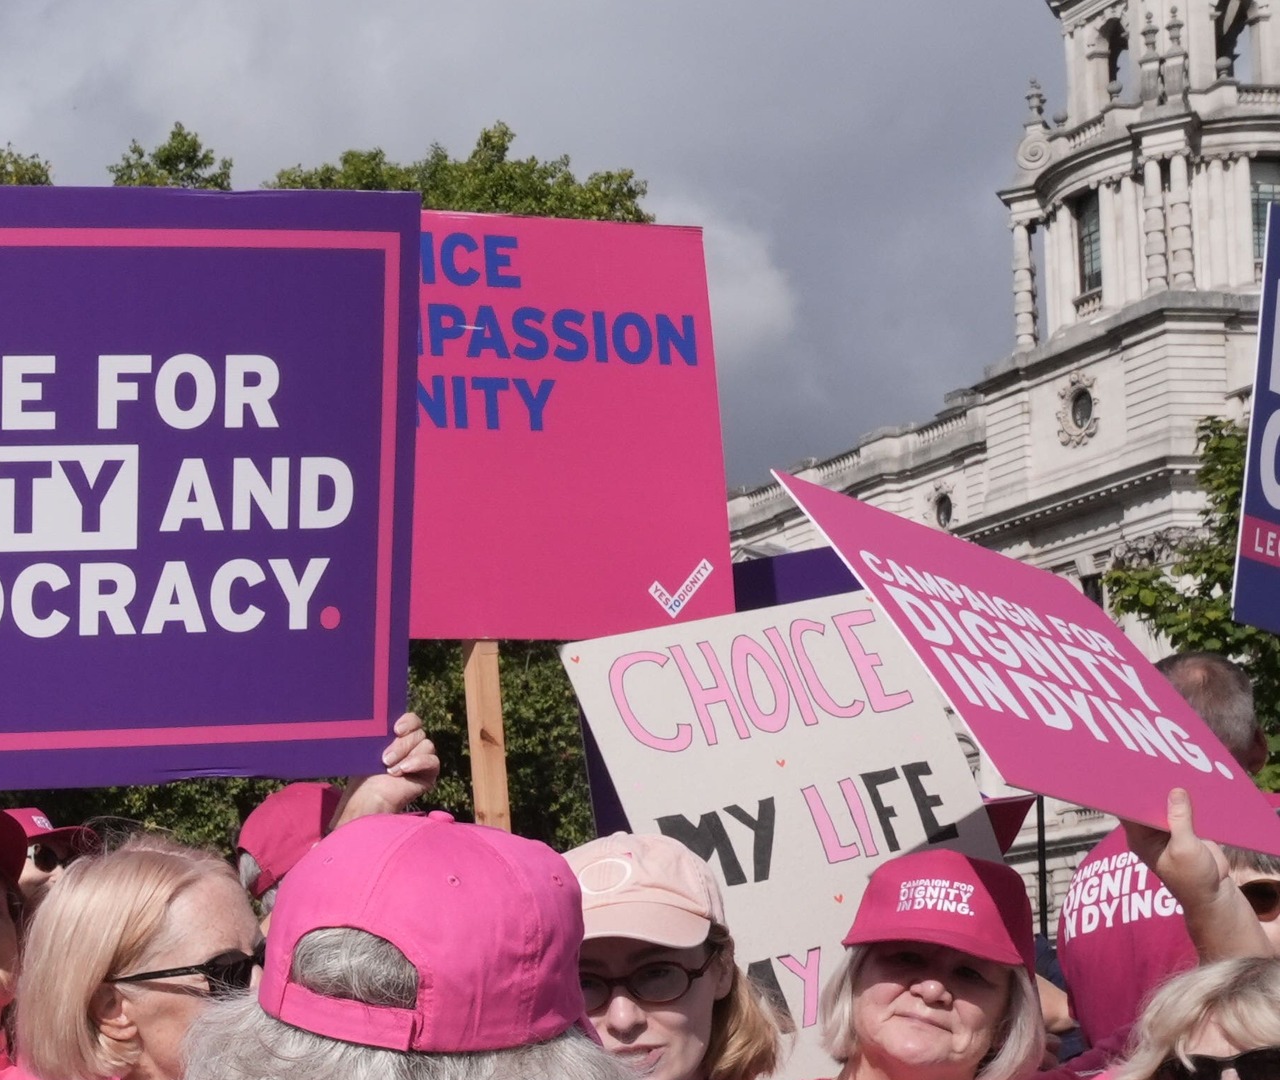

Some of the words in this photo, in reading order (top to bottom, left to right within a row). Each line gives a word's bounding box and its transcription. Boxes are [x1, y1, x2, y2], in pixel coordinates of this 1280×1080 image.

[418, 303, 698, 366] PASSION
[97, 353, 280, 430] FOR
[160, 456, 354, 532] AND
[653, 585, 671, 606] YES
[859, 549, 1048, 636] CAMPAIGN
[1046, 613, 1125, 661] FOR
[609, 609, 913, 752] CHOICE
[882, 584, 1161, 713] DIGNITY
[930, 645, 1031, 721] IN
[1006, 669, 1234, 780] DYING.
[800, 760, 959, 864] LIFE
[896, 900, 912, 912] IN
[913, 898, 975, 916] DYING.
[900, 886, 972, 903] DIGNITY
[901, 879, 950, 889] CAMPAIGN
[953, 881, 975, 892] FOR
[1063, 862, 1165, 915] DIGNIT
